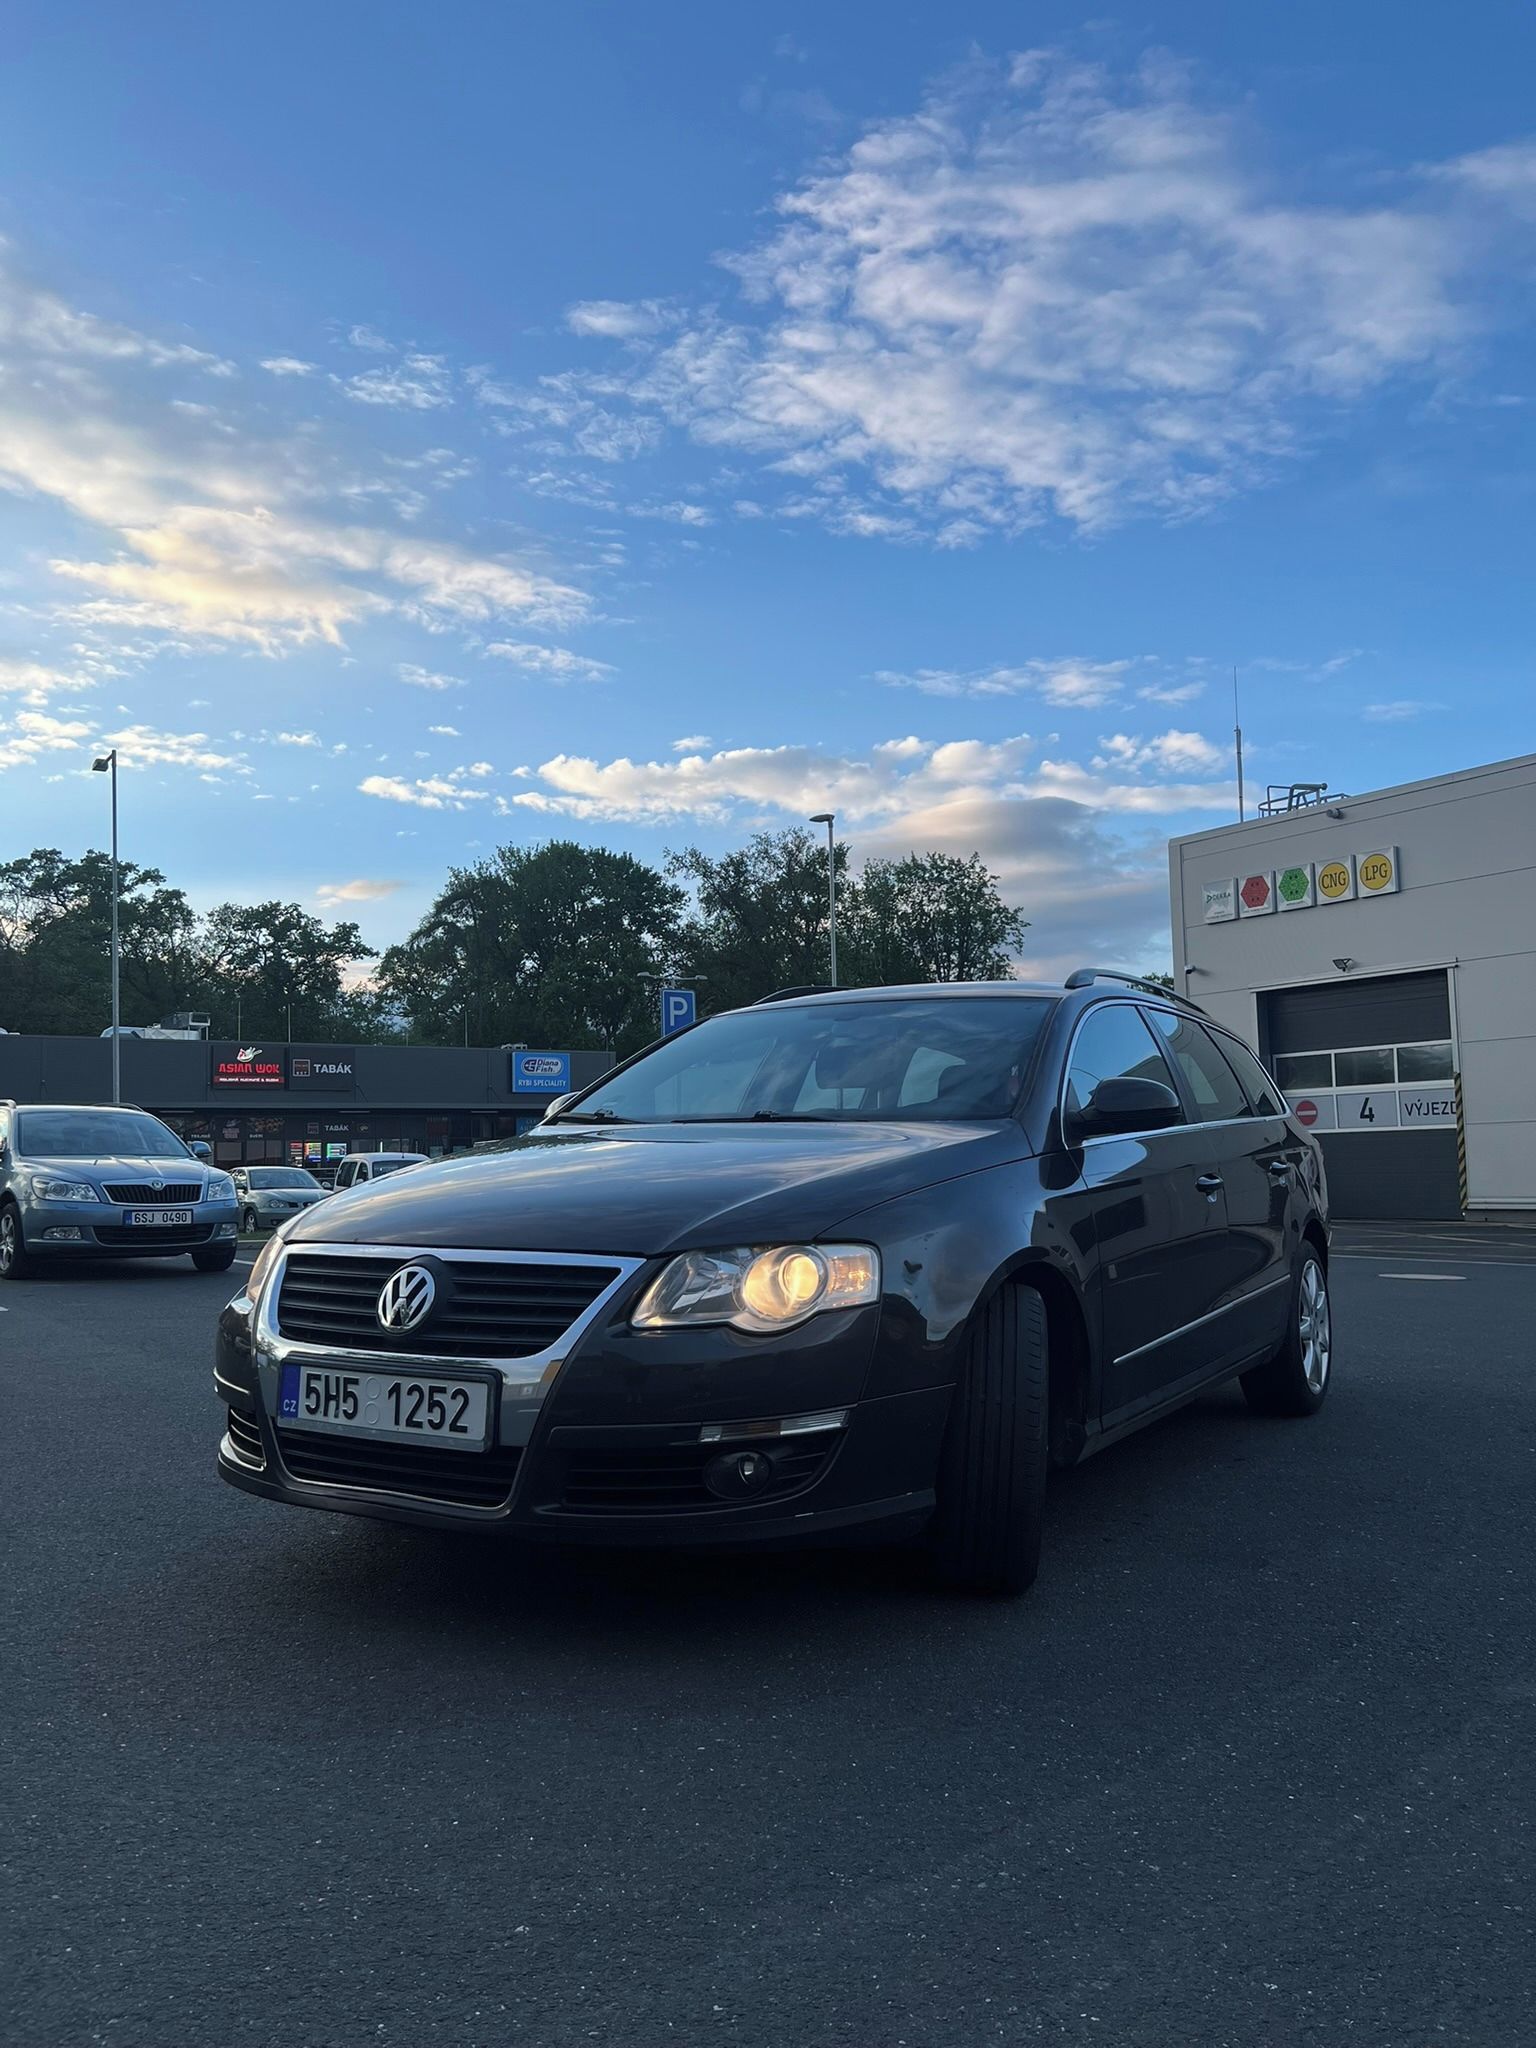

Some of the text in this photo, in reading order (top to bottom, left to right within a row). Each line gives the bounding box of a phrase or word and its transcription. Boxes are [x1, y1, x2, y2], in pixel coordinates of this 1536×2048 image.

[1321, 870, 1347, 889] CNG
[1364, 862, 1388, 881] LPG
[670, 996, 688, 1026] P
[218, 1063, 280, 1073] ASIAN WOK
[313, 1062, 352, 1074] TABÁK
[534, 1079, 566, 1087] SPECIALITY
[1360, 1097, 1375, 1122] 4
[134, 1212, 155, 1223] 6SJ
[162, 1212, 187, 1223] 0490
[283, 1399, 296, 1412] CZ
[305, 1372, 469, 1434] 5H5 1252
